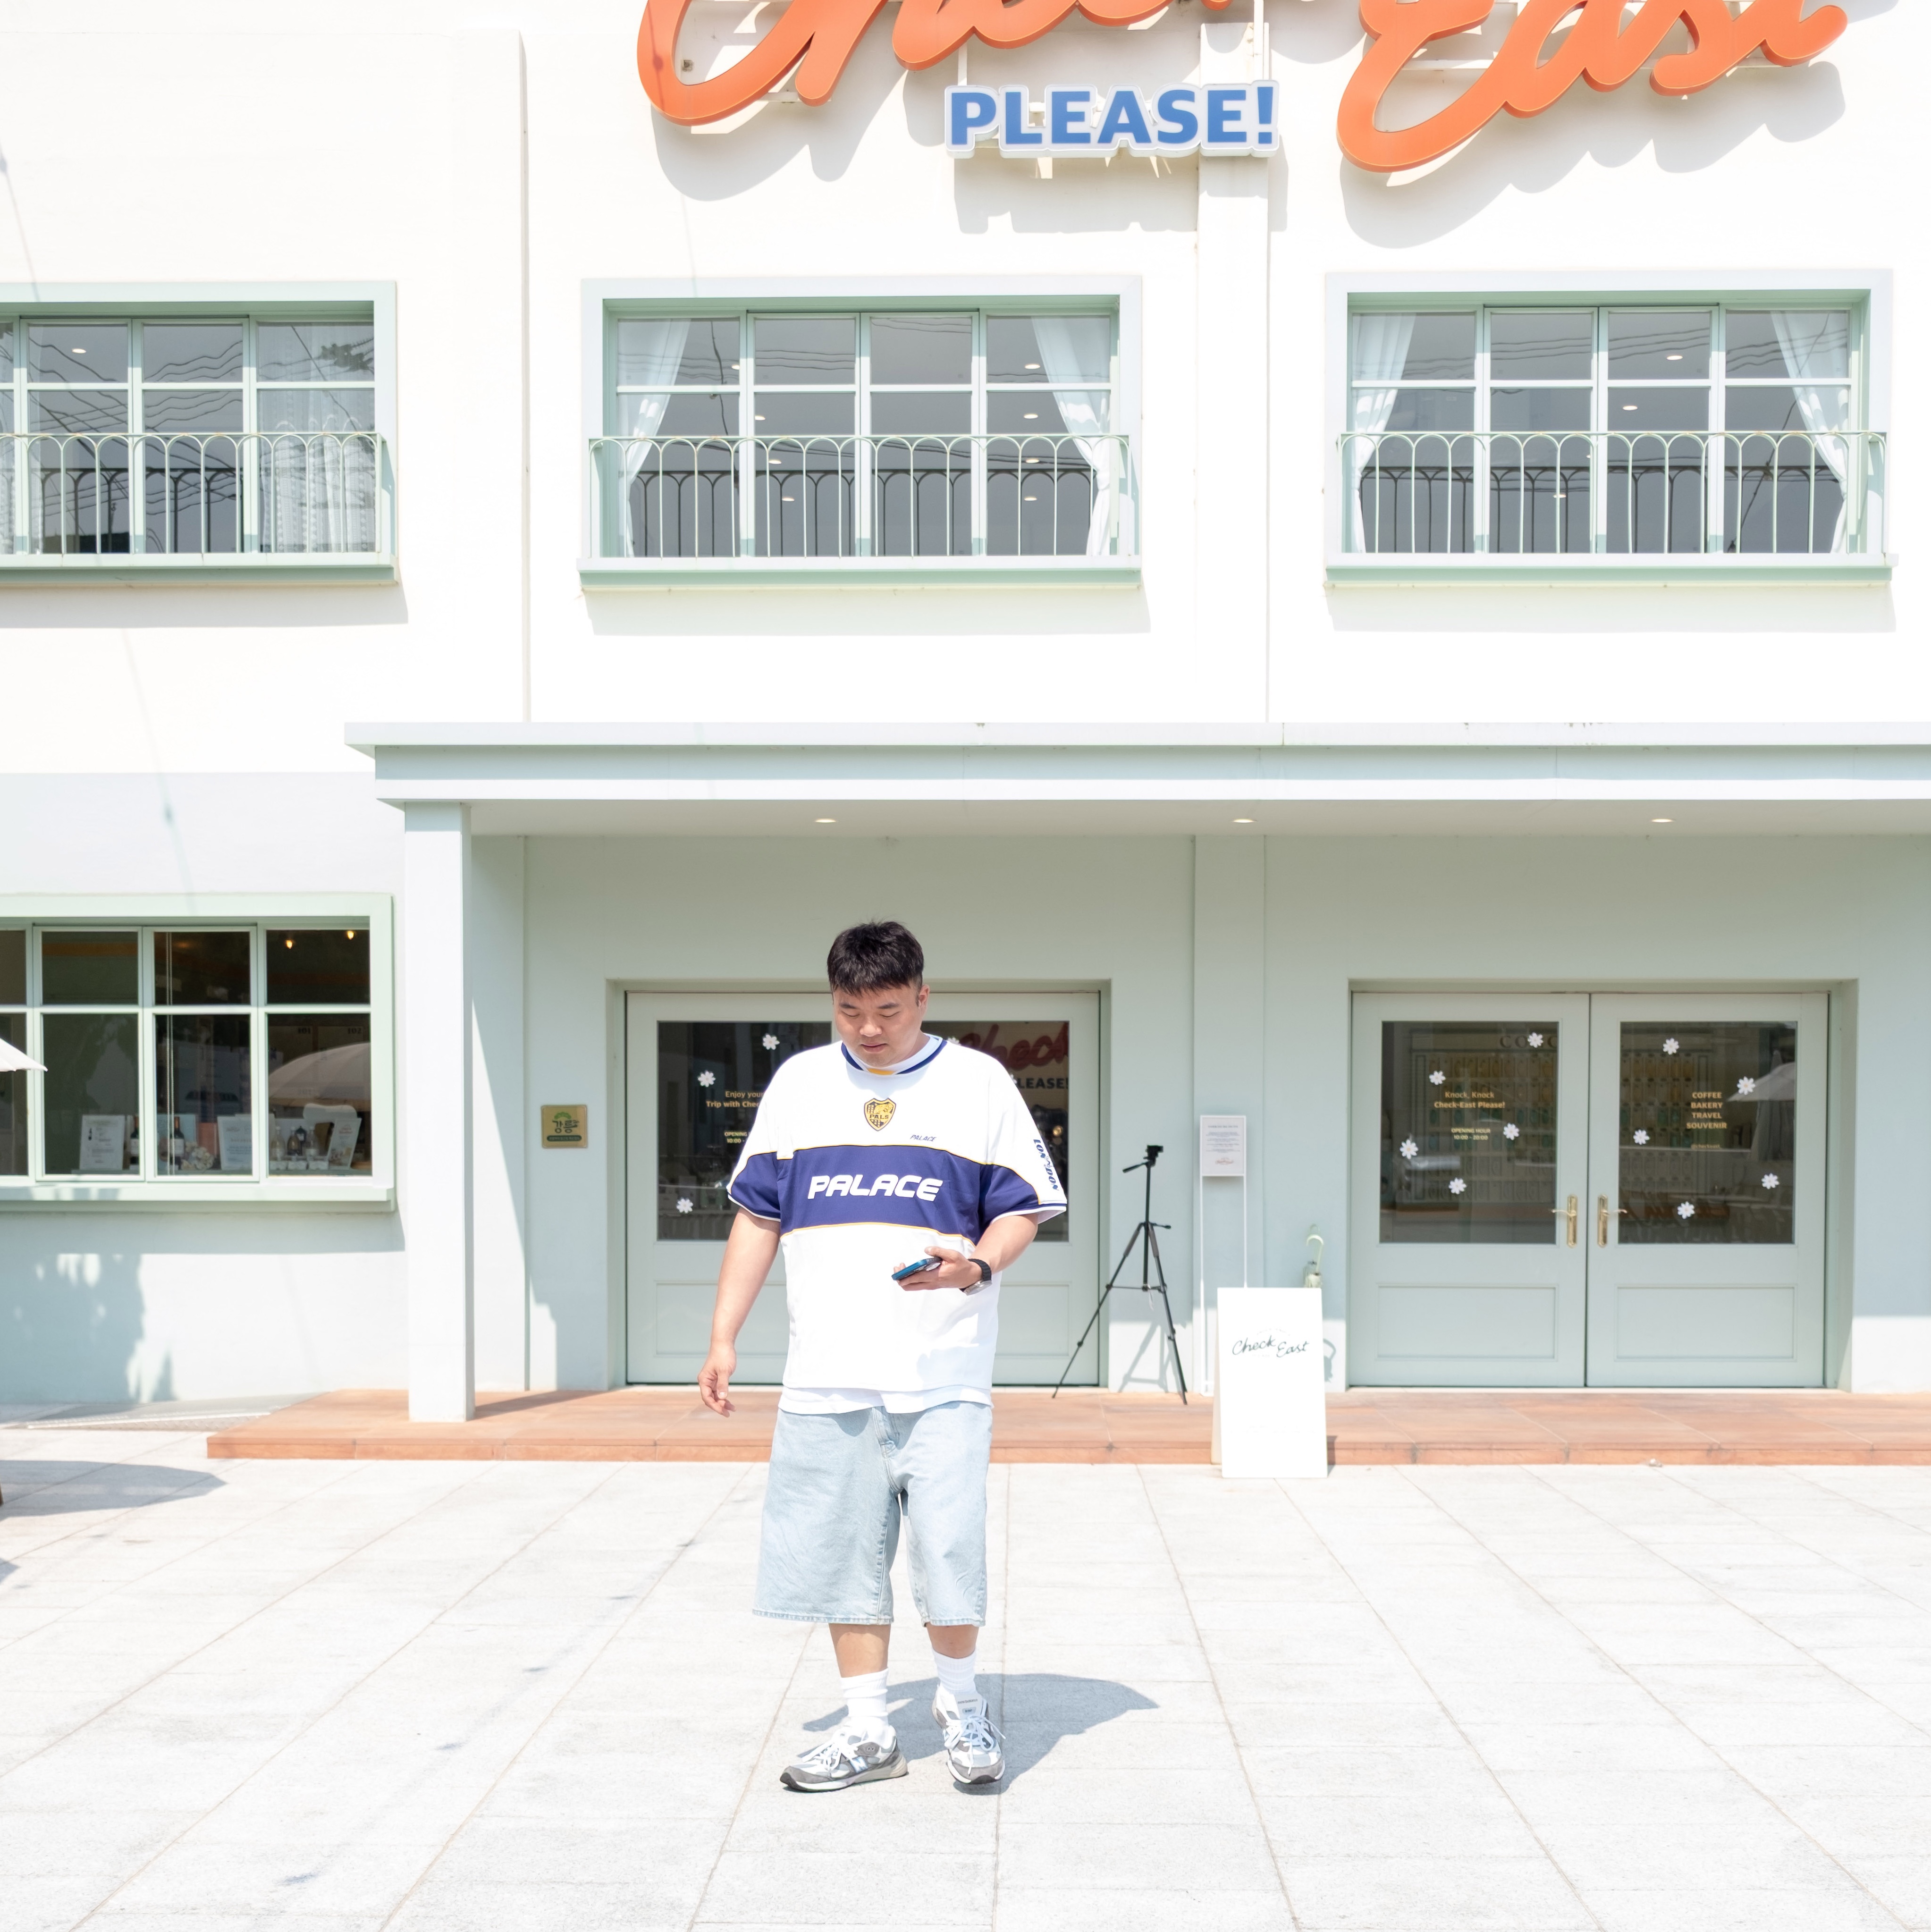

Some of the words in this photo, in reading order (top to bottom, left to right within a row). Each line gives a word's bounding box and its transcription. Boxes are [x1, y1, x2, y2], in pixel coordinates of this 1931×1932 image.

[950, 86, 1274, 146] PLEASE!
[1017, 1078, 1069, 1089] LEASE!
[808, 1174, 943, 1202] PALACE
[1232, 1335, 1276, 1355] Check
[1276, 1341, 1309, 1358] East
